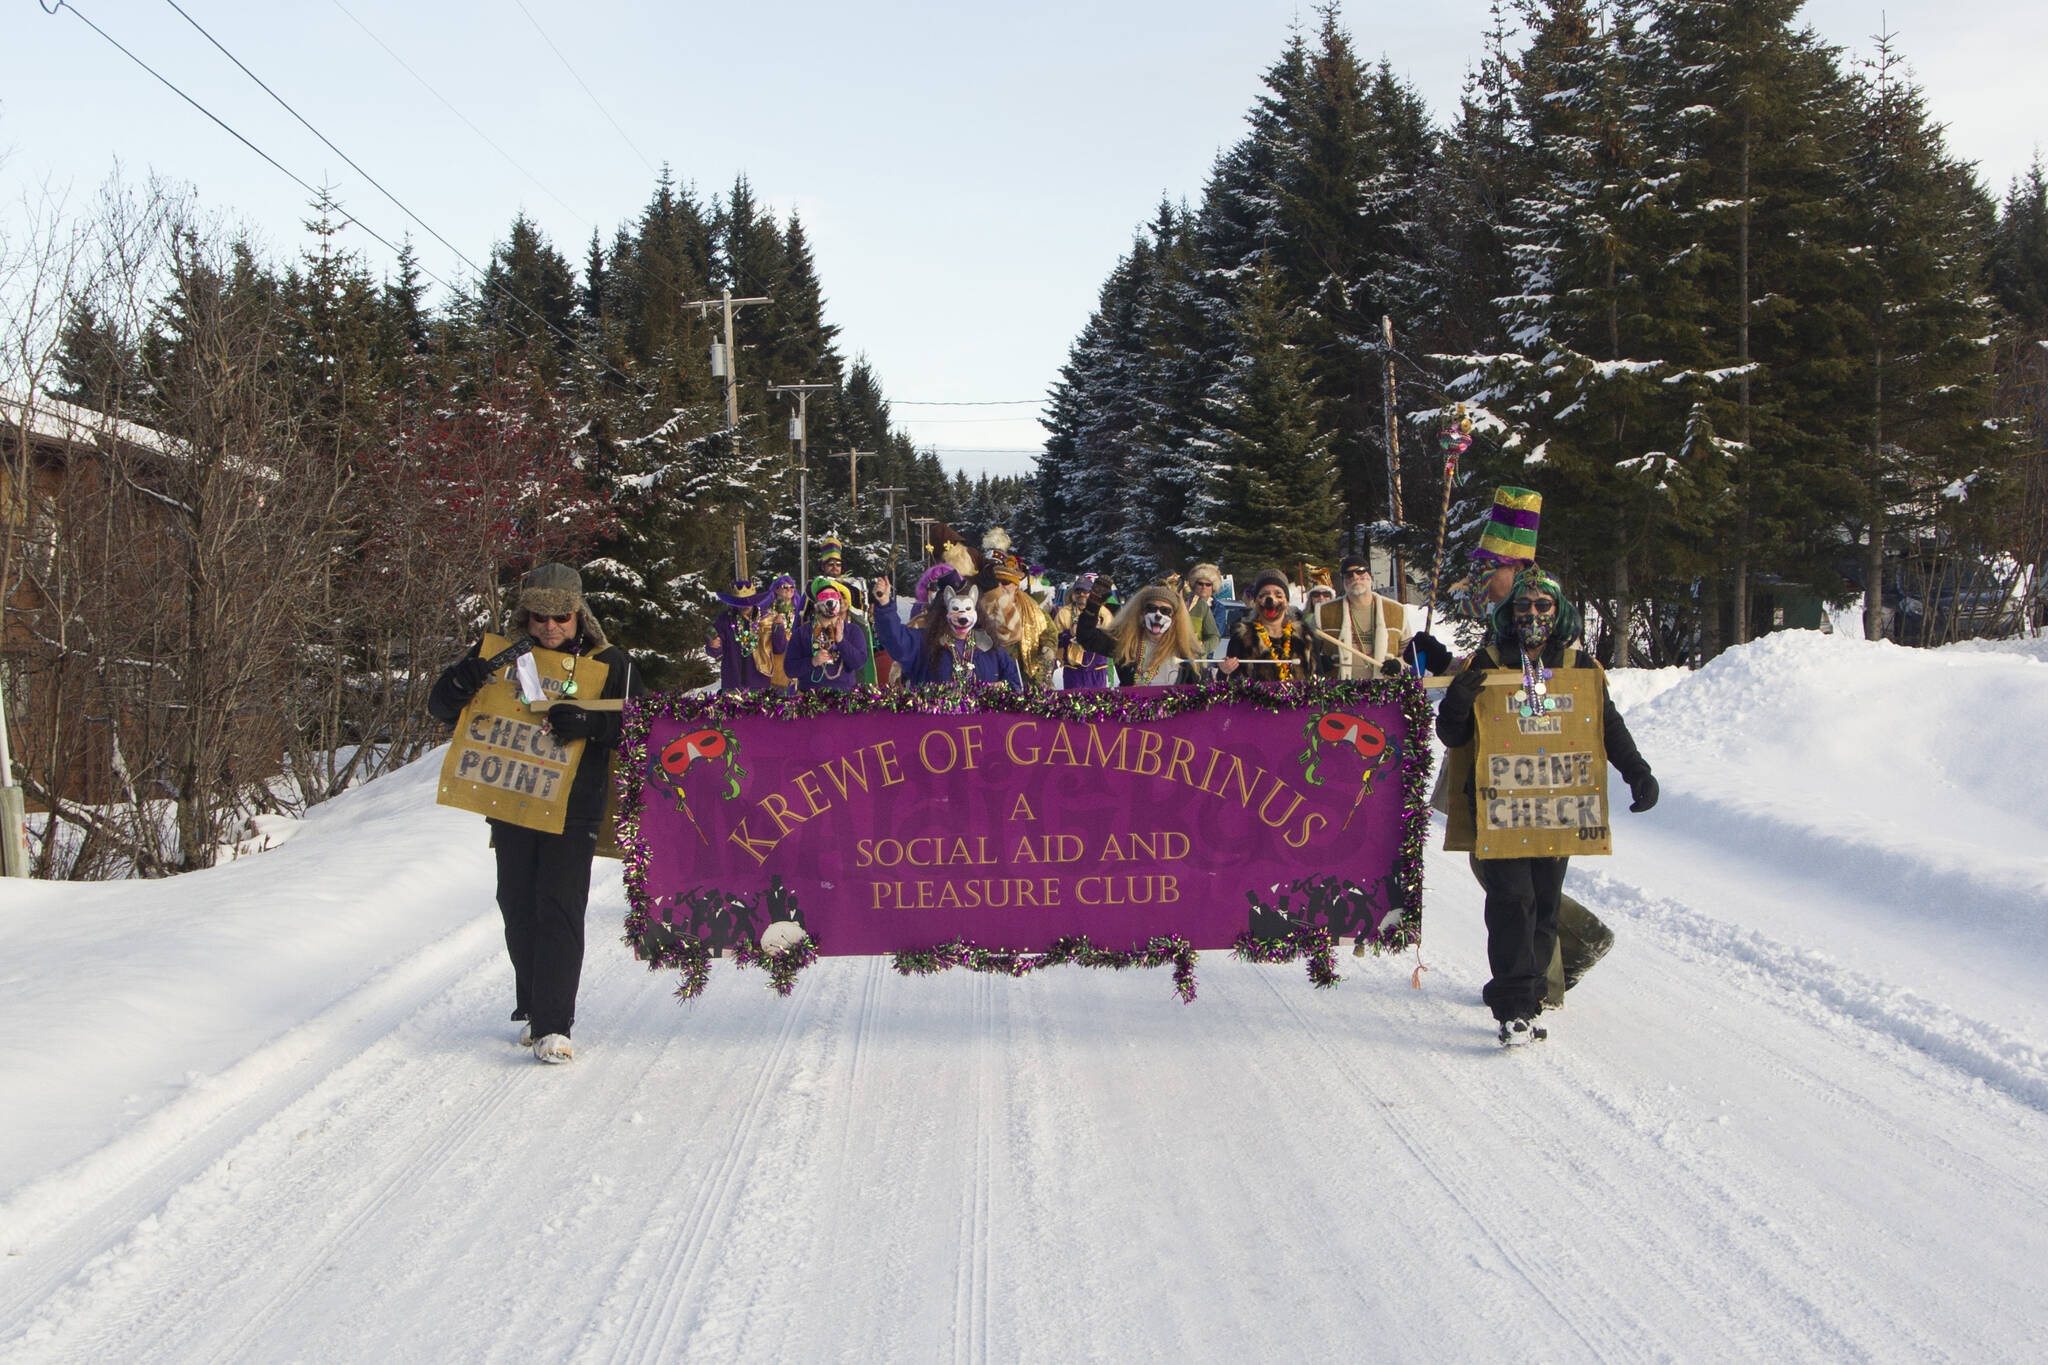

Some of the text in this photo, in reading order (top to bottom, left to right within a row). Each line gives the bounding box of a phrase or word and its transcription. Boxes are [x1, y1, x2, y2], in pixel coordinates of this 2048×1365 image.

[458, 750, 560, 797] POINT
[1491, 754, 1592, 786] POINT
[728, 721, 1328, 867] KREWE OF GAMBRINUS
[1008, 793, 1037, 821] A
[1480, 787, 1498, 801] TO
[1489, 796, 1599, 829] CHECK
[856, 832, 1190, 867] SOCIAL AID AND
[1578, 827, 1607, 840] OUT
[871, 875, 1180, 909] PLEASURE CLUB
